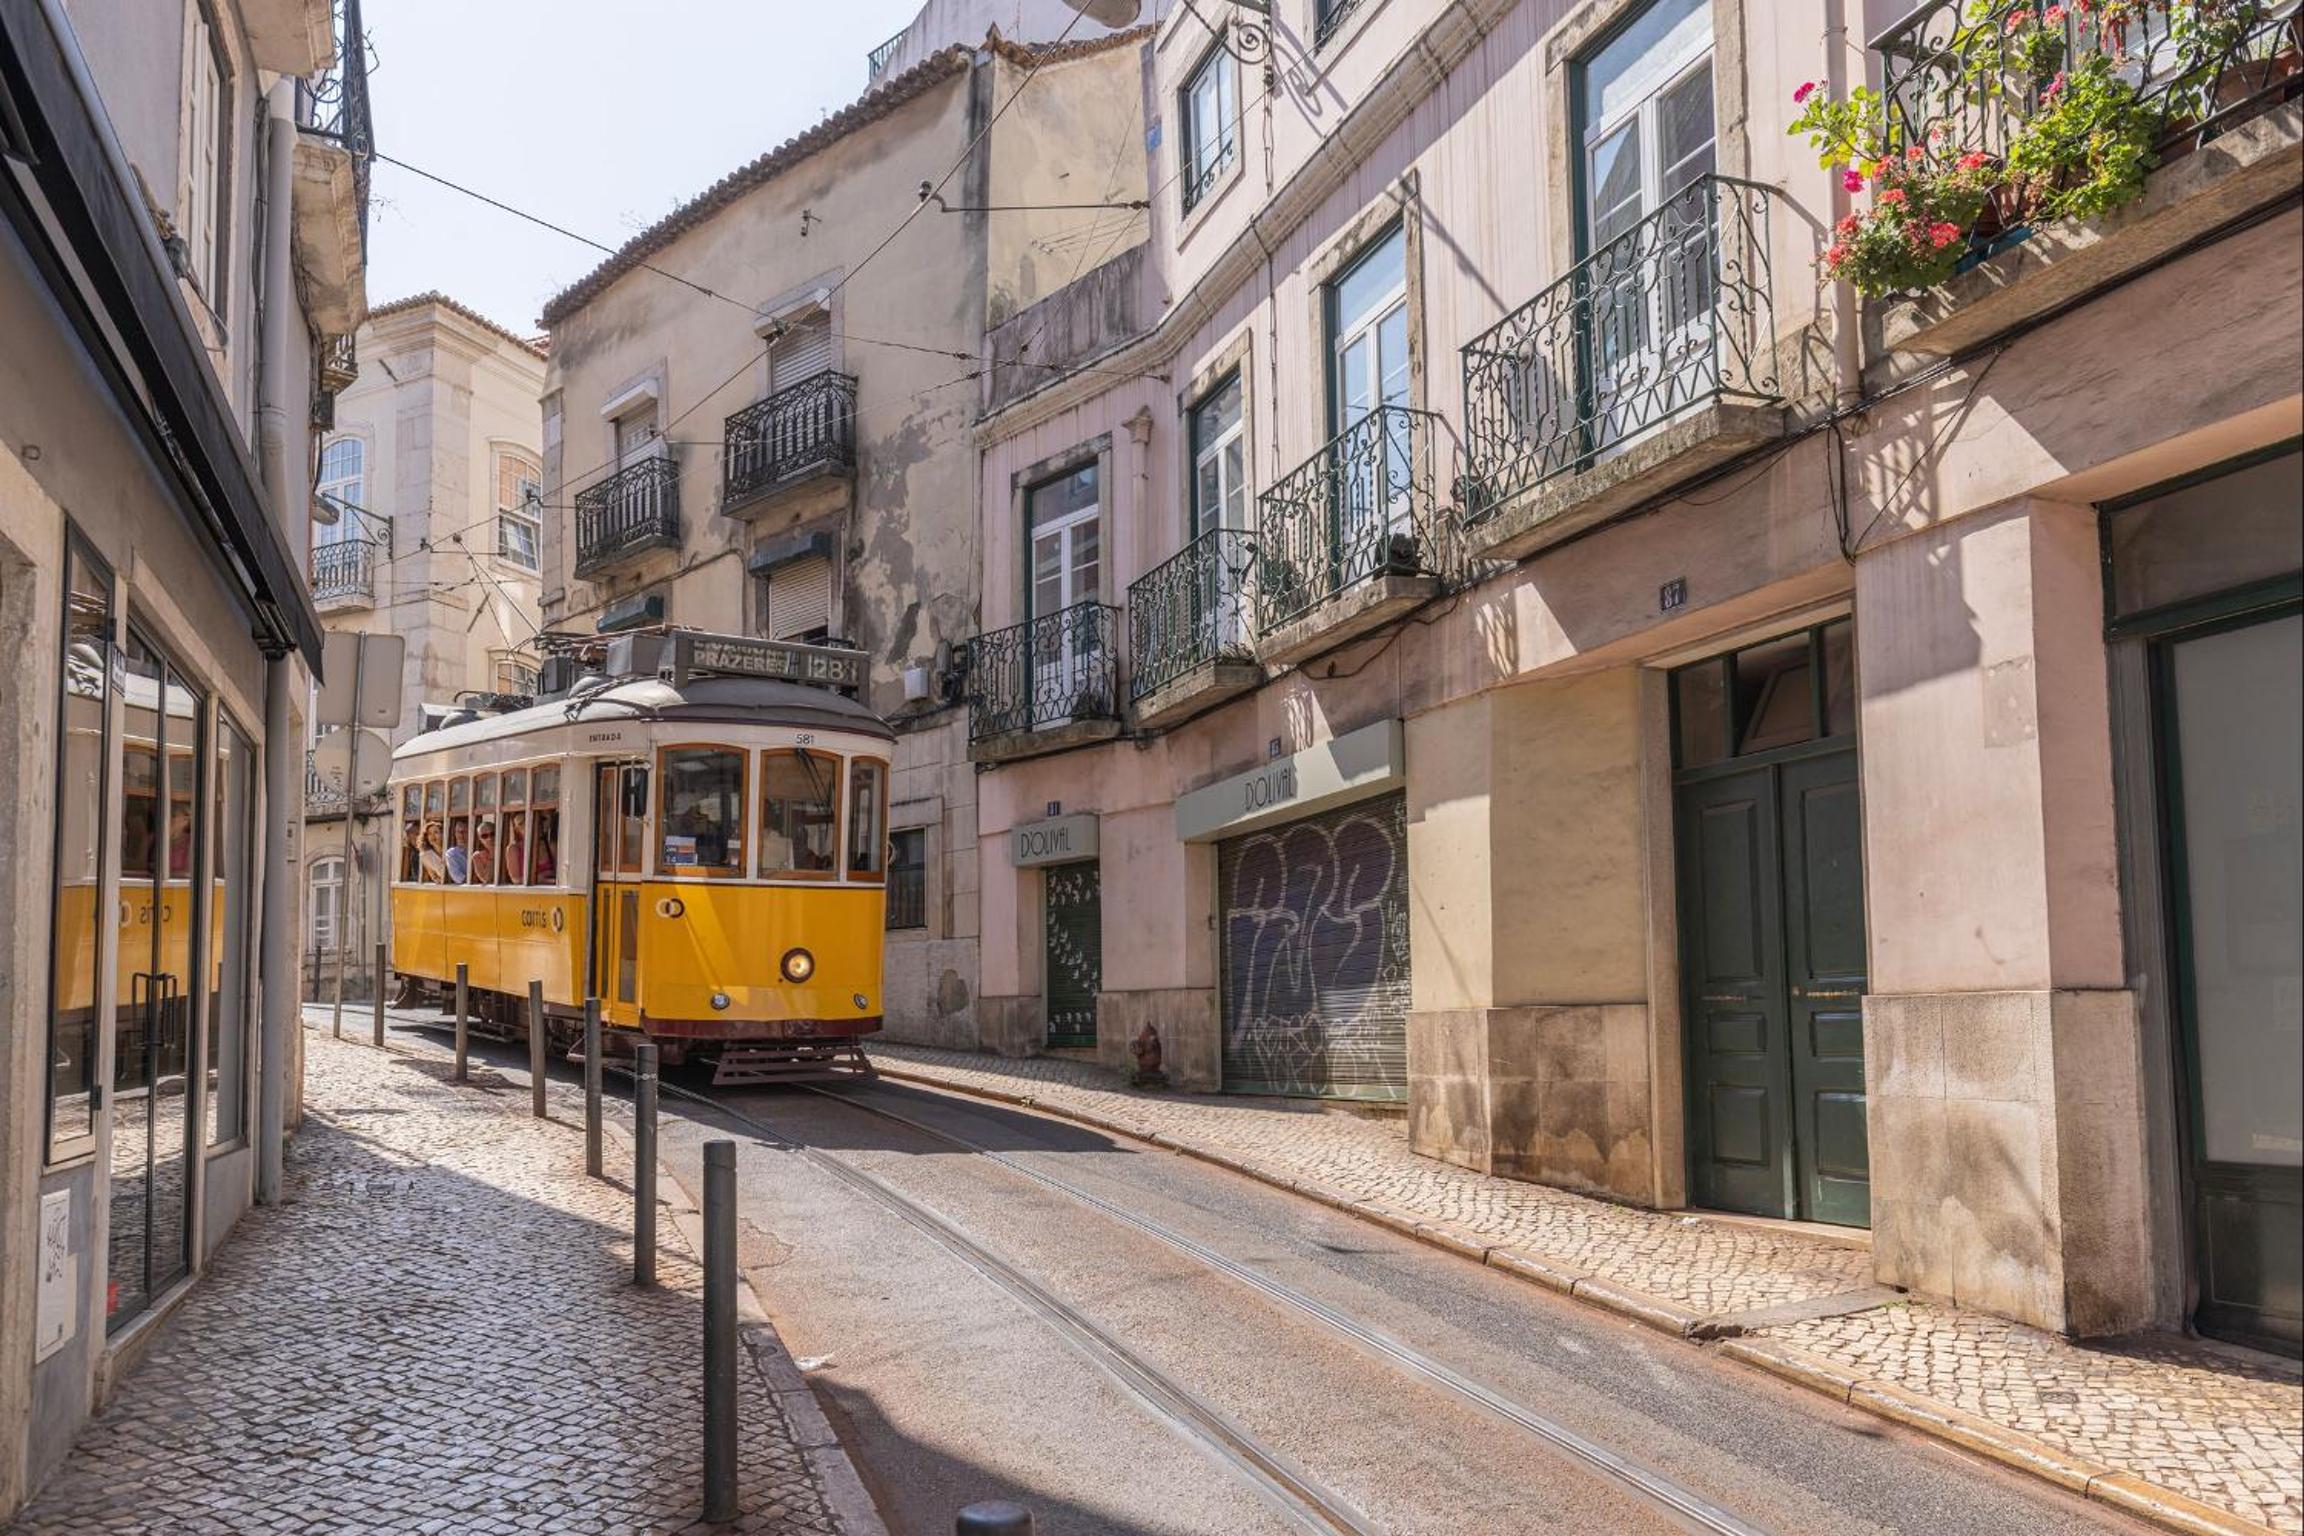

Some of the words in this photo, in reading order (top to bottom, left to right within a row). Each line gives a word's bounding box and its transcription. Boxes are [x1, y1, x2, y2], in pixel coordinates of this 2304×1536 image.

[1664, 583, 1680, 609] 87
[693, 649, 787, 676] PRAZERES
[796, 733, 814, 745] 581
[1020, 826, 1072, 859] D'OLIVAL
